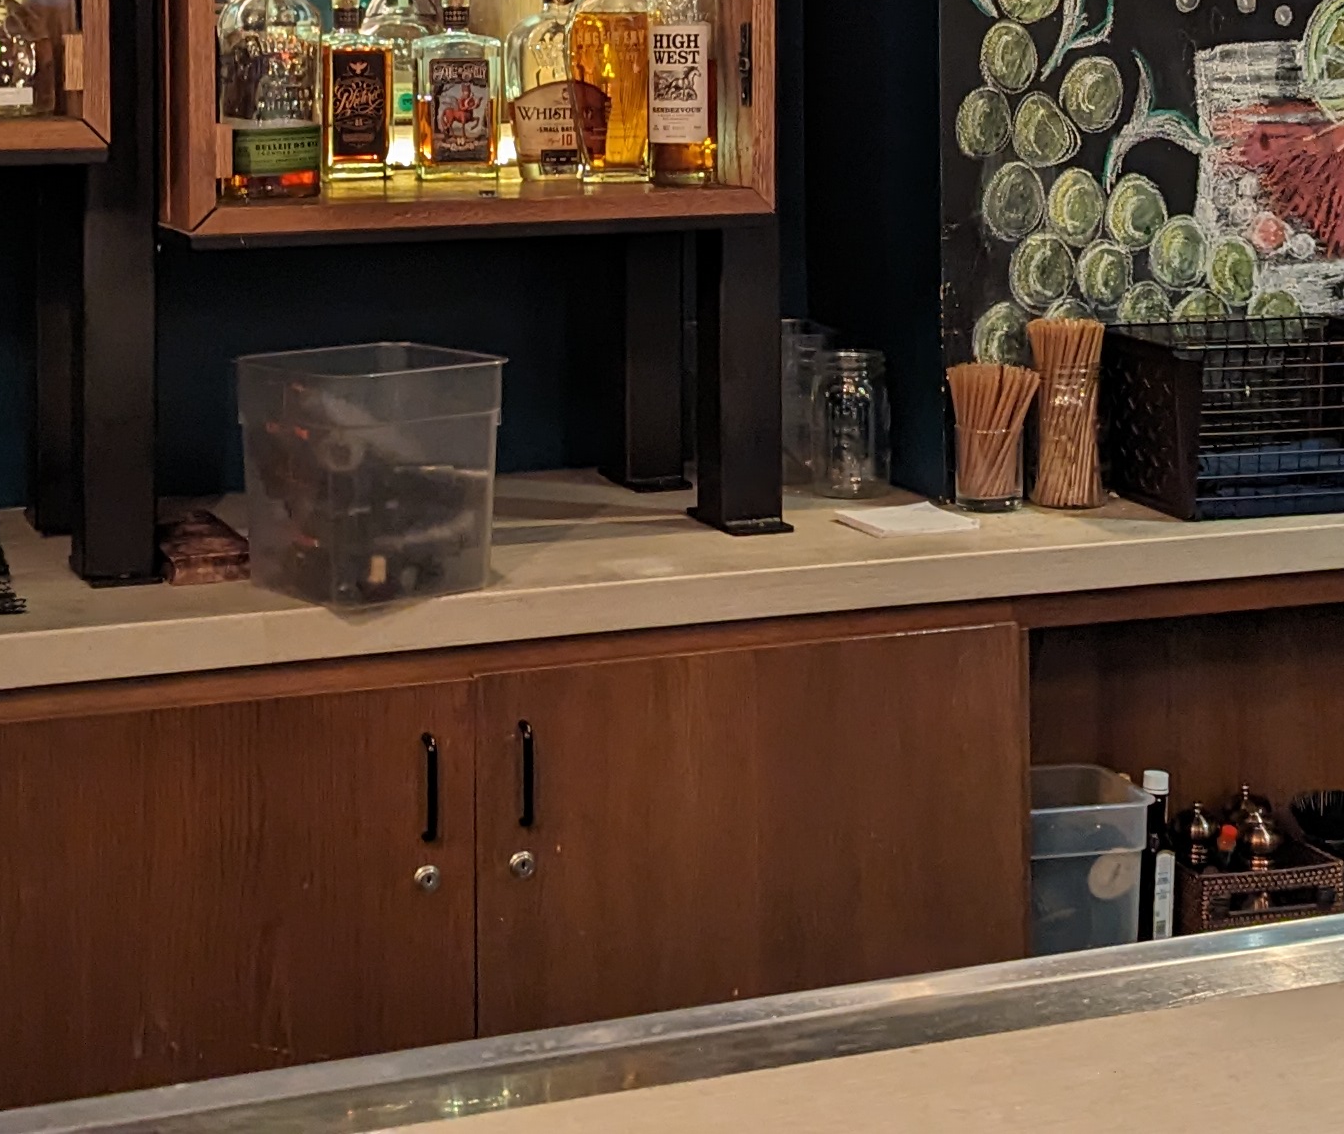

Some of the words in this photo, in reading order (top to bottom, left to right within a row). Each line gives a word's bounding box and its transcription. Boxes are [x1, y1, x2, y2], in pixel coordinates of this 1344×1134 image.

[653, 34, 700, 49] HIGH
[654, 50, 700, 64] WEST
[562, 133, 573, 146] 10
